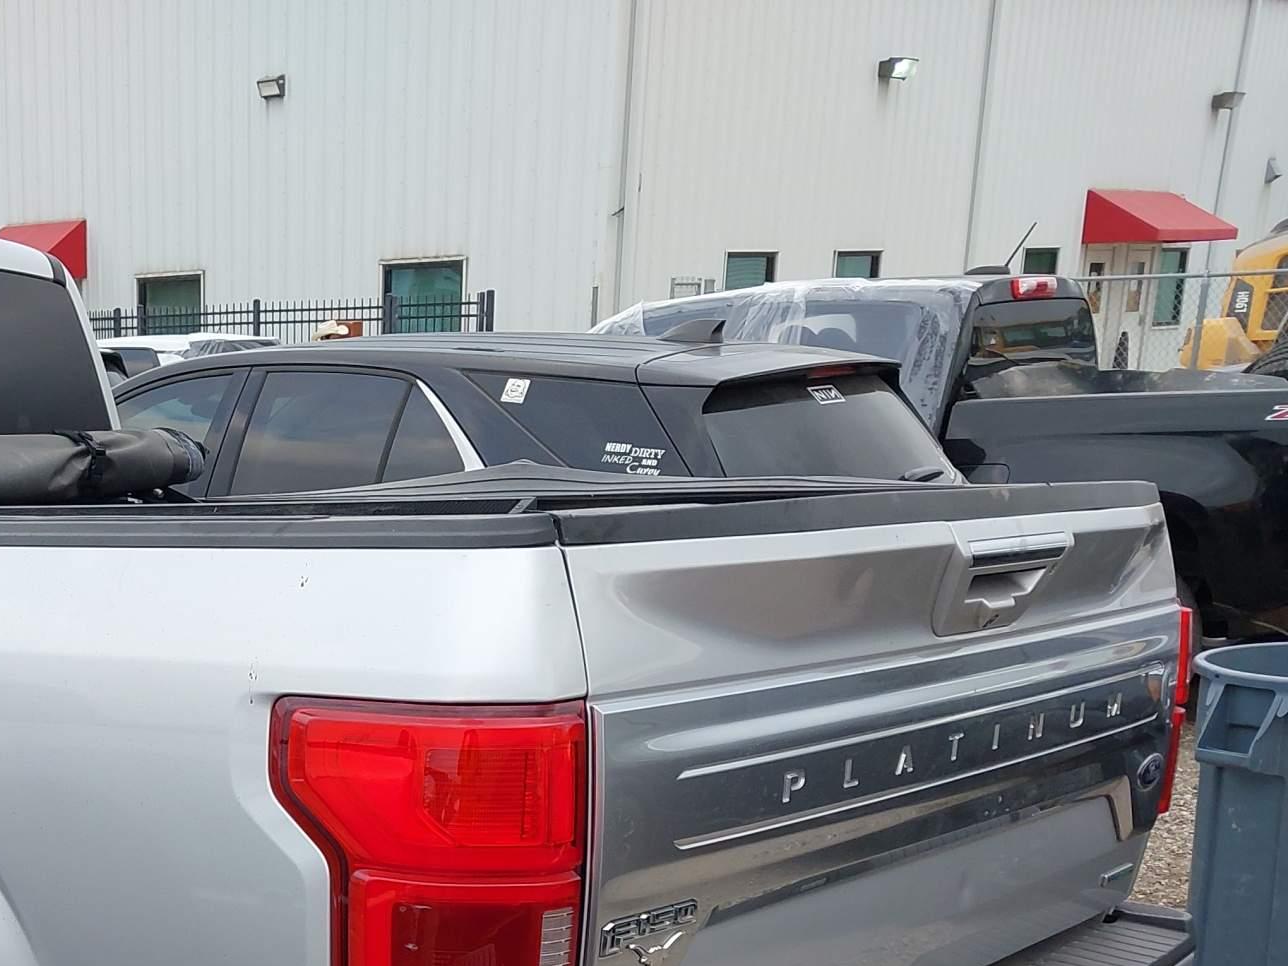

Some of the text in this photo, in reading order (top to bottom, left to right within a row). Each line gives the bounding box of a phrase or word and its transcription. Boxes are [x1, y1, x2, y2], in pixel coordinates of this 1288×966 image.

[605, 442, 665, 459] NERDY DIRTY
[601, 454, 658, 466] INKED AND
[782, 692, 1122, 803] PLATINUM
